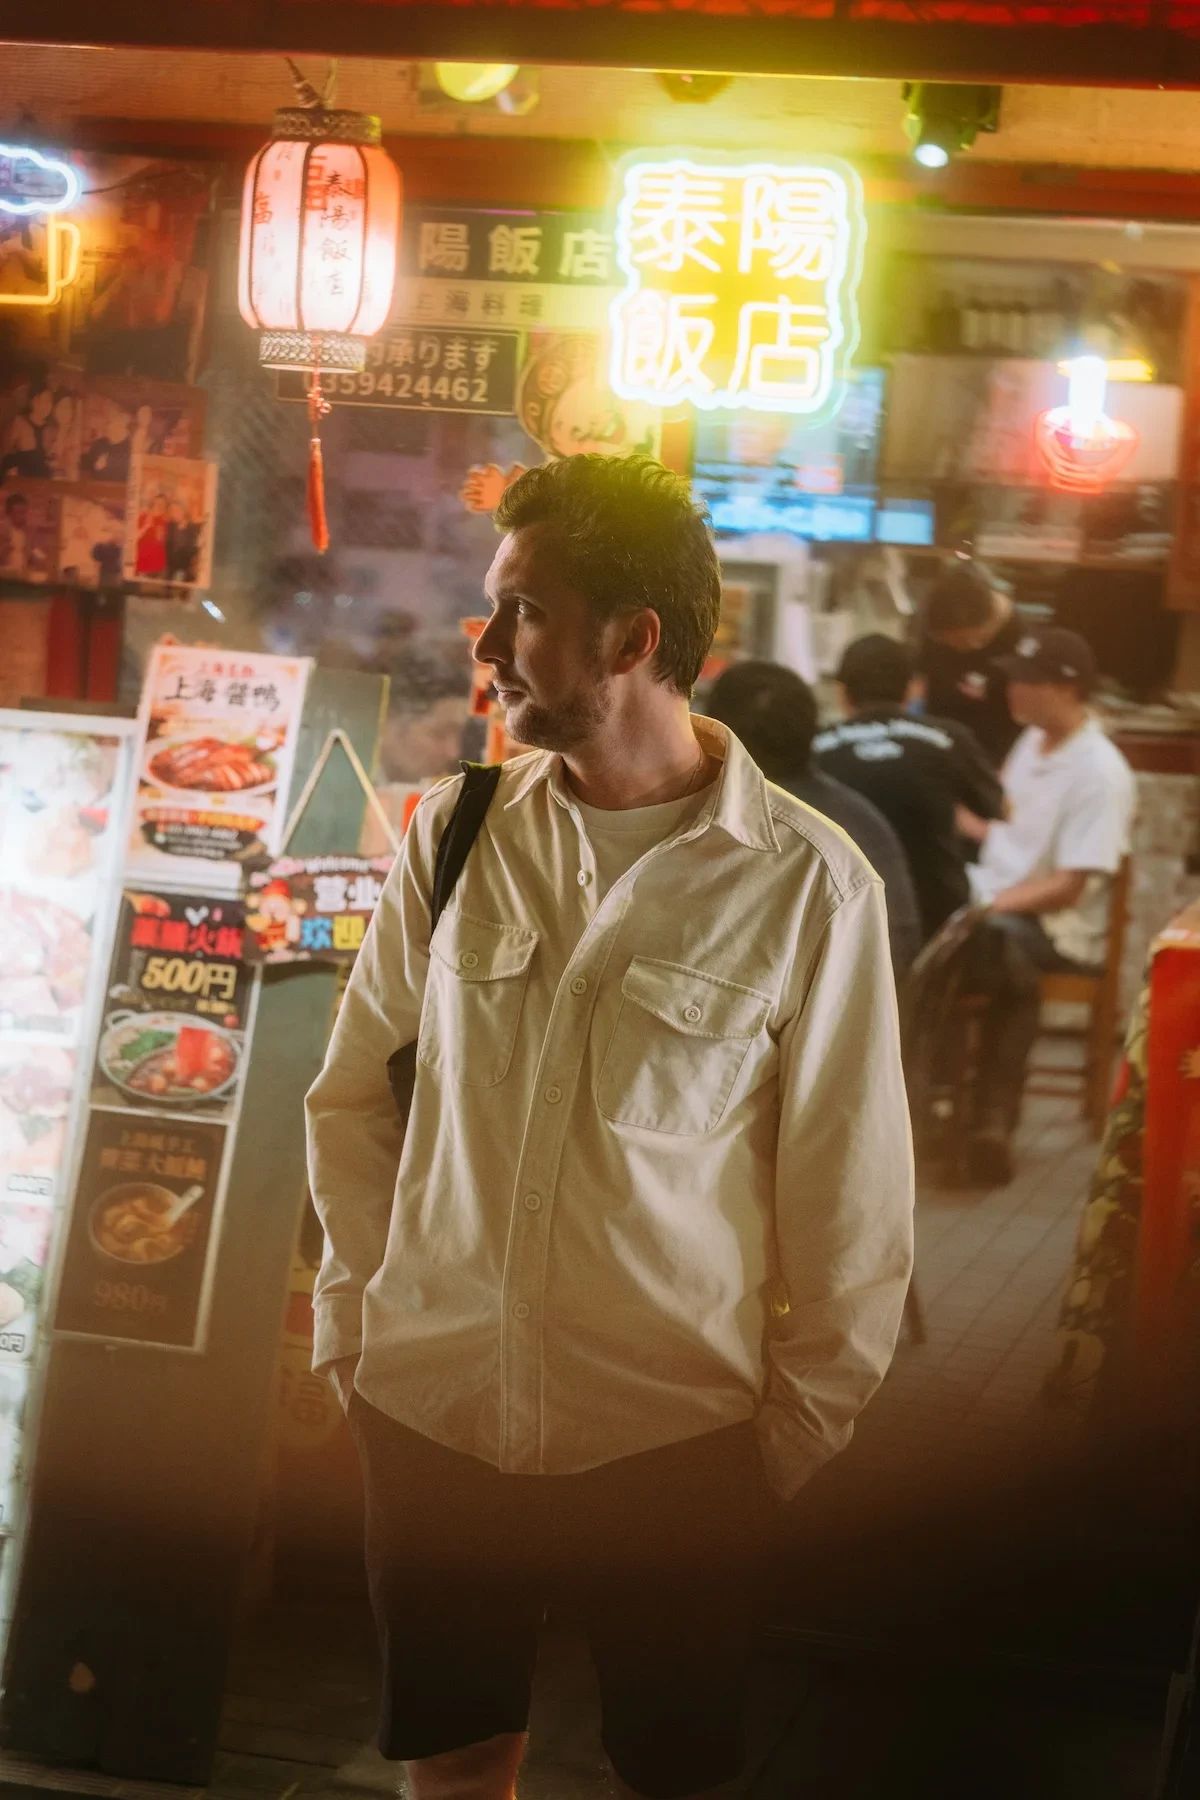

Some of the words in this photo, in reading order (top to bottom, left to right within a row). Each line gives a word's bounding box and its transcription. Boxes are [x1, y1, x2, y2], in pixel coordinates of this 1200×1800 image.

[630, 172, 836, 281] 泰陽
[618, 289, 830, 398] 飯店
[142, 956, 237, 1000] 500円
